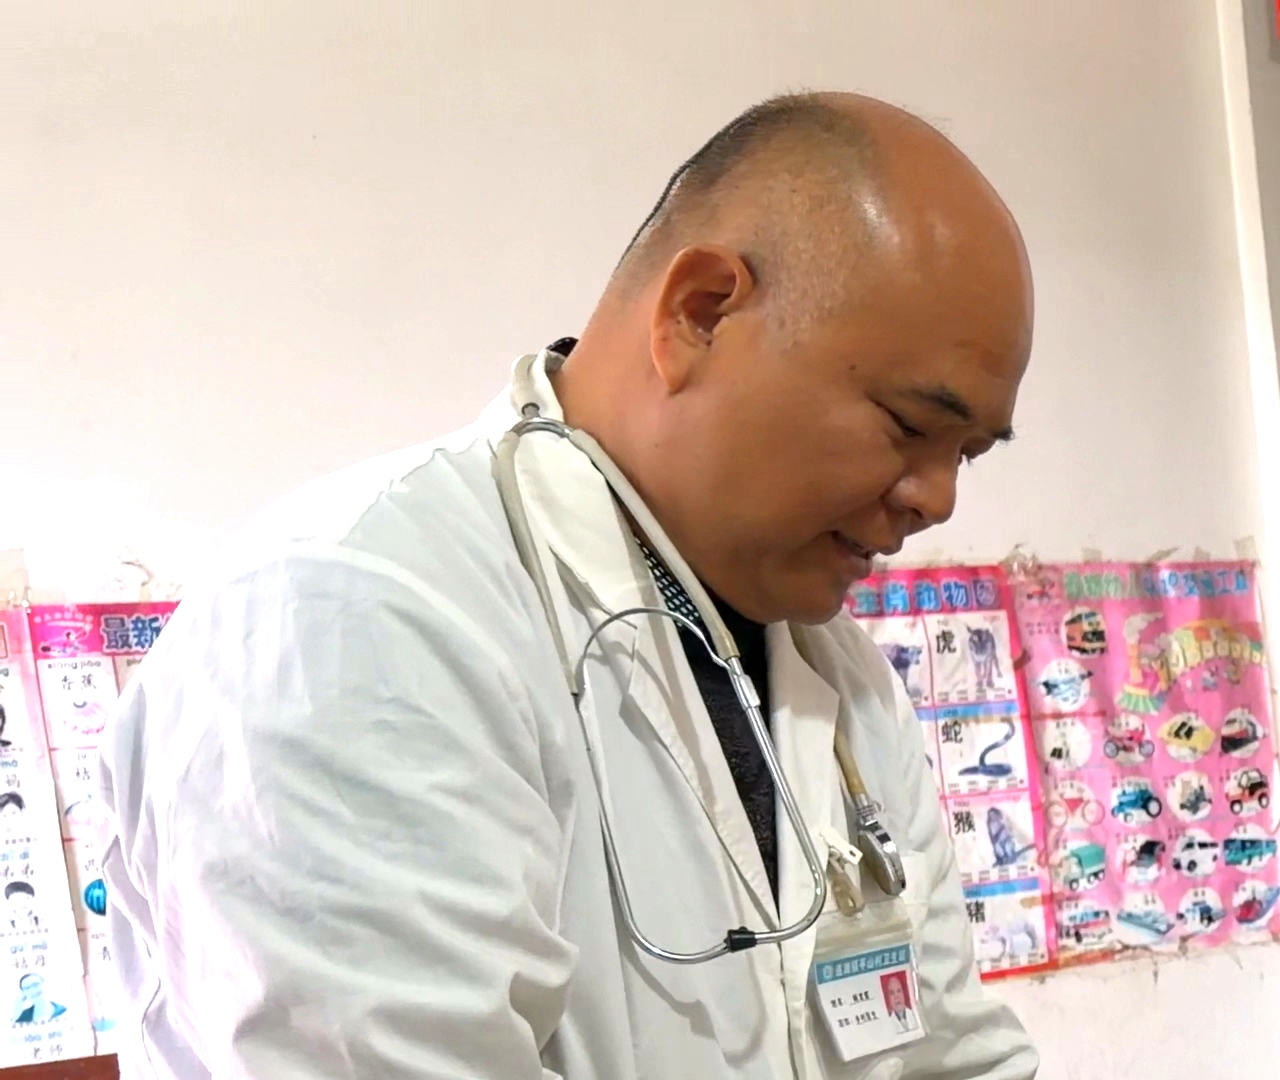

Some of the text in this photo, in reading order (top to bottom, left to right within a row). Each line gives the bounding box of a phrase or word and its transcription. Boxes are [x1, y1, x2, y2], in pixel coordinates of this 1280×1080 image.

[936, 630, 957, 654] 虎
[941, 720, 963, 743] 蛇
[952, 811, 976, 835] 猴
[965, 900, 986, 923] 猪
